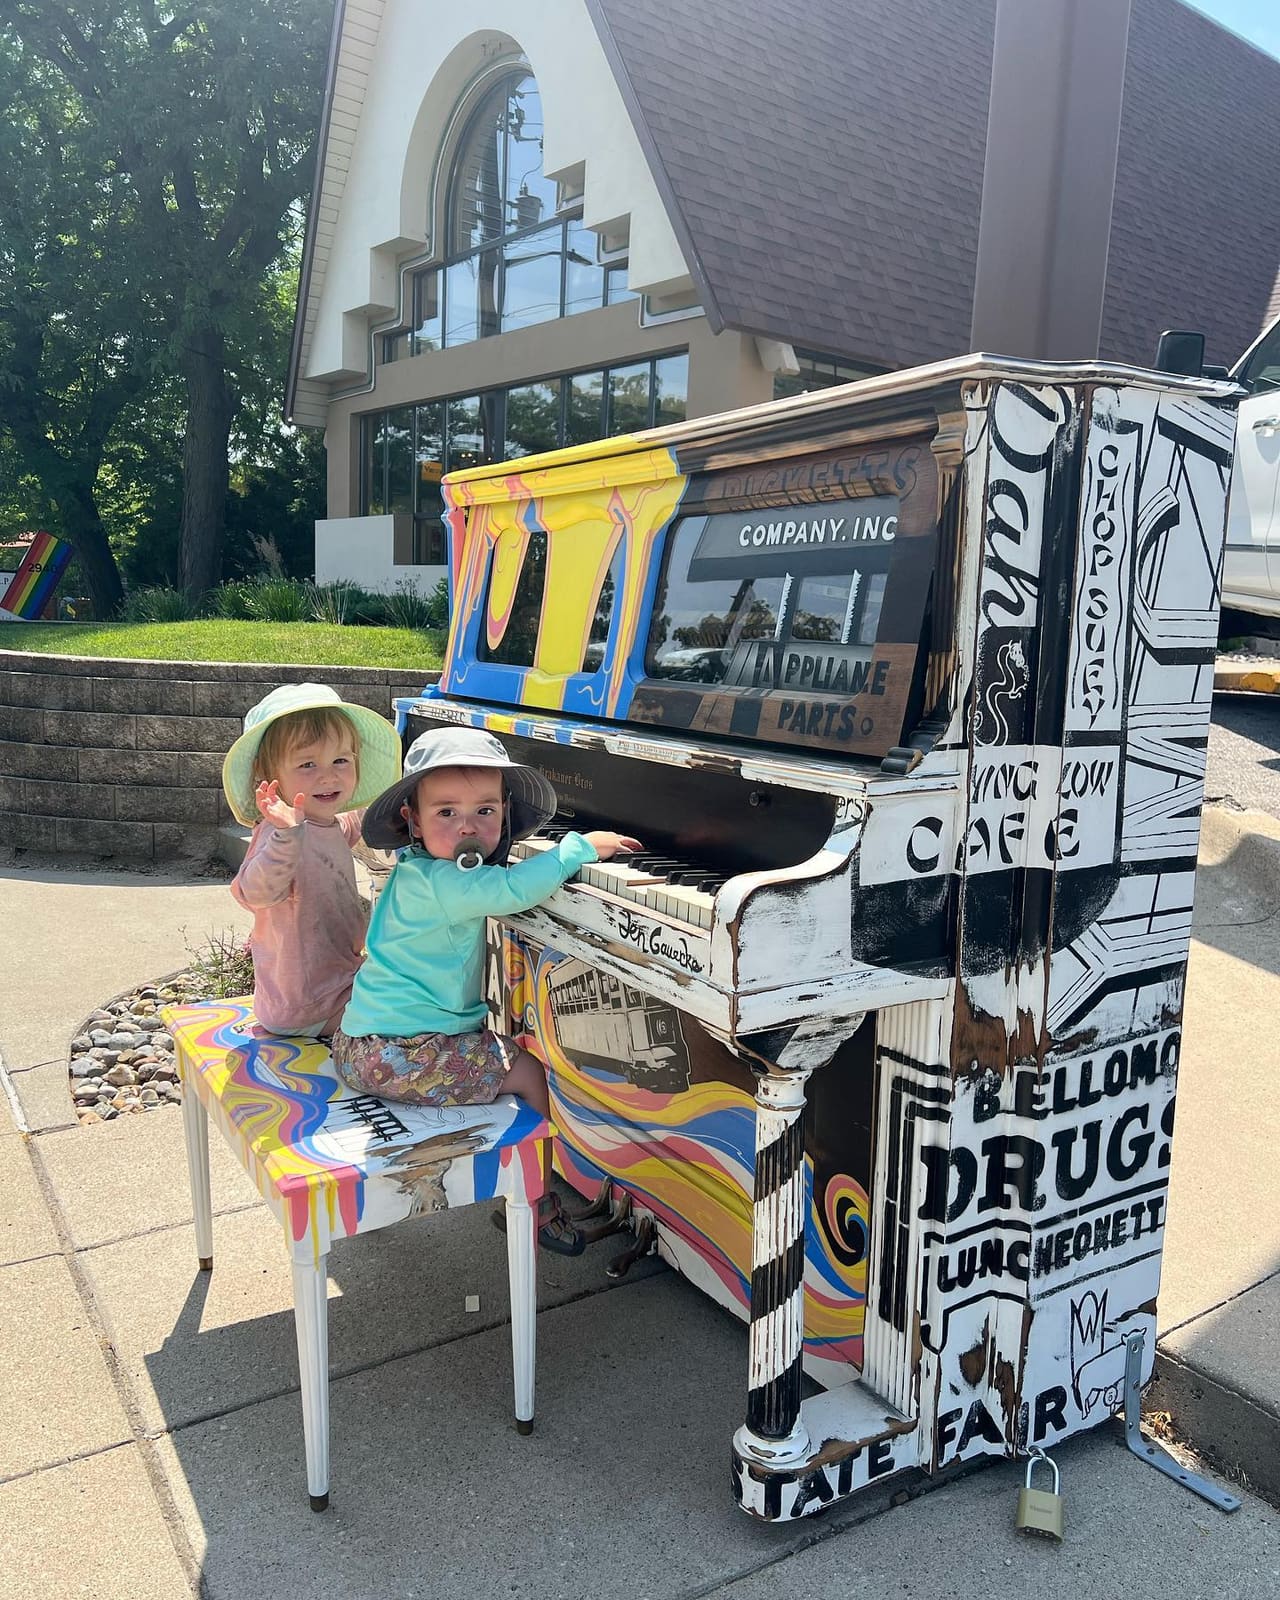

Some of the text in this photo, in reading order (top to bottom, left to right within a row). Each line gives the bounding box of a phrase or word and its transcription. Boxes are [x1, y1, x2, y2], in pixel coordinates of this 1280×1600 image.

[1080, 444, 1119, 730] CHOP SUEY
[776, 700, 857, 741] PARTS
[1055, 759, 1114, 801] LOW
[906, 808, 1081, 873] CAFE
[618, 909, 649, 954] Jen
[938, 1385, 1068, 1464] FAIR
